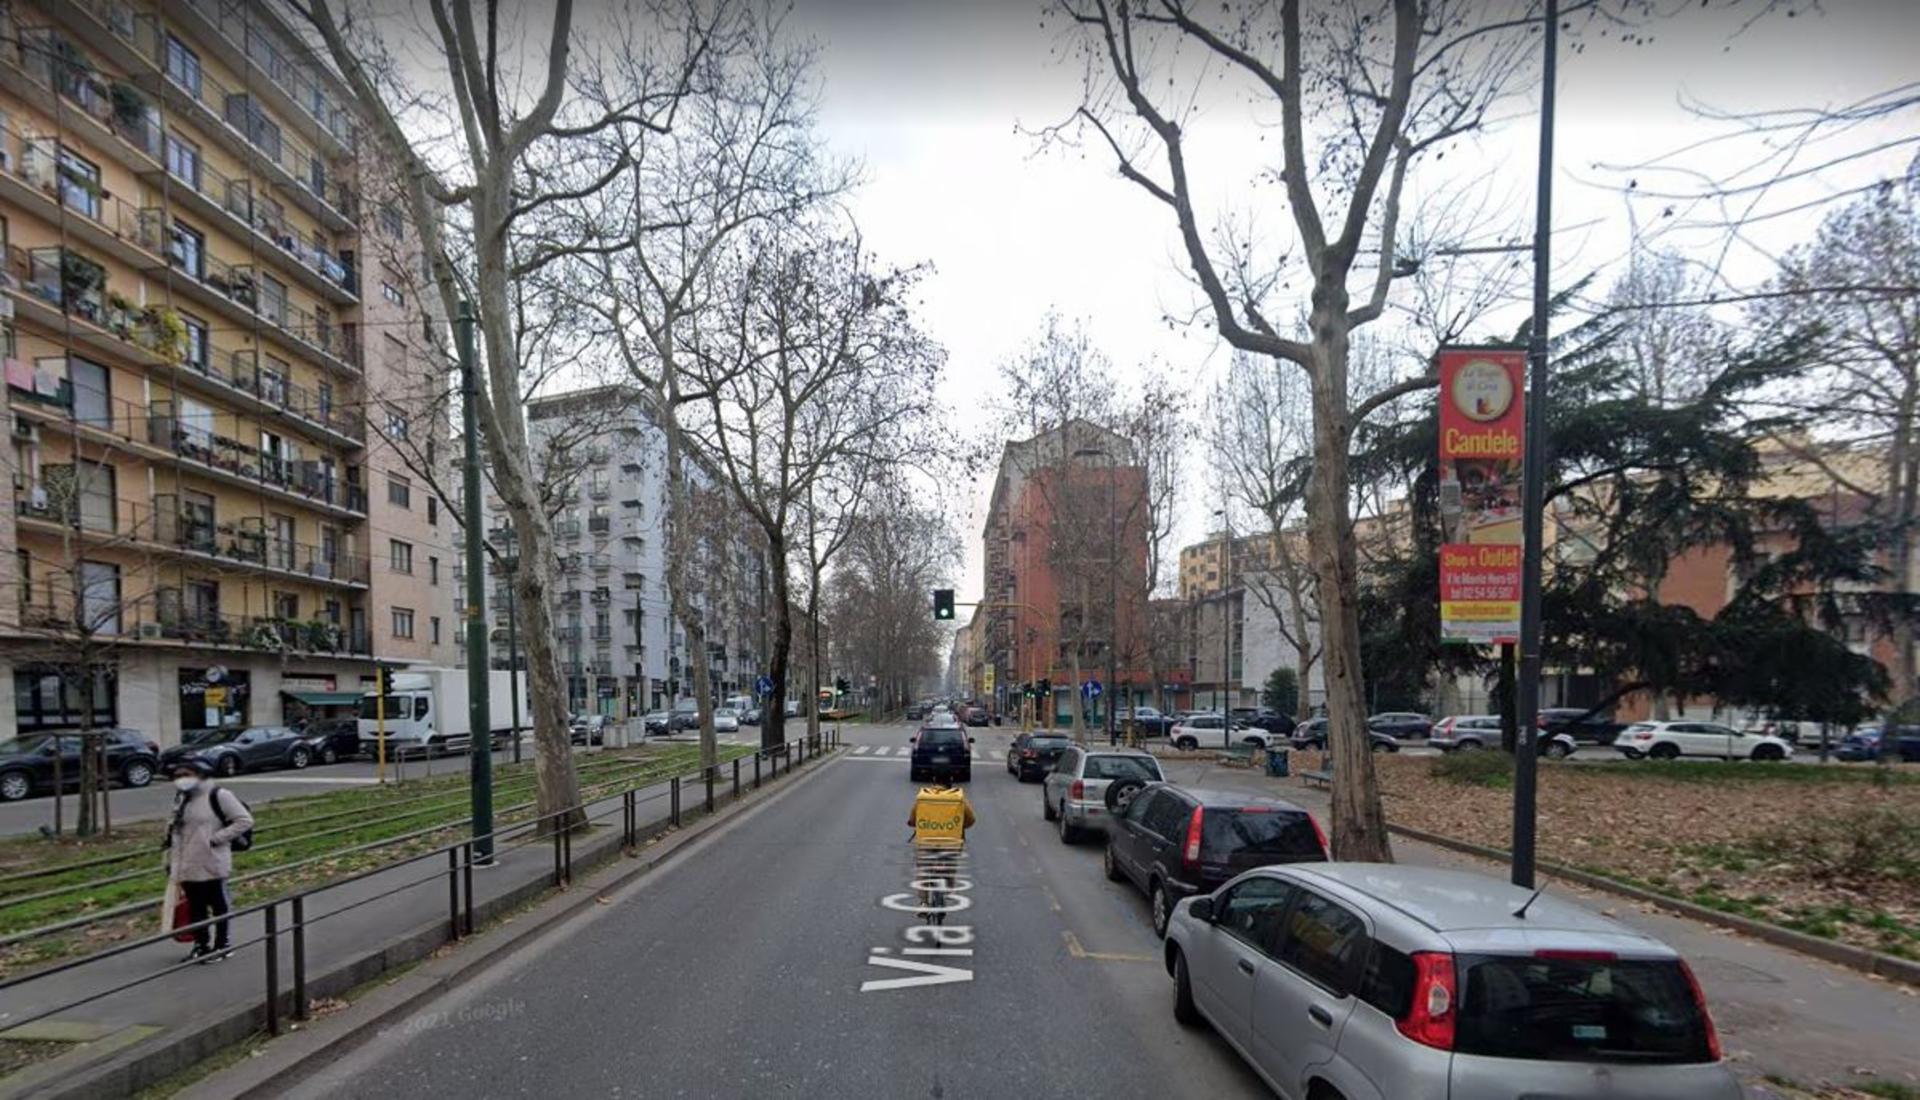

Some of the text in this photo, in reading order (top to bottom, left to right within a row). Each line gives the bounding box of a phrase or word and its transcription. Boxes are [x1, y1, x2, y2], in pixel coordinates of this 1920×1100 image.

[1446, 428, 1519, 454] Candele
[1445, 553, 1468, 568] Shop
[1479, 547, 1518, 567] Outlet
[918, 815, 961, 831] Glovo
